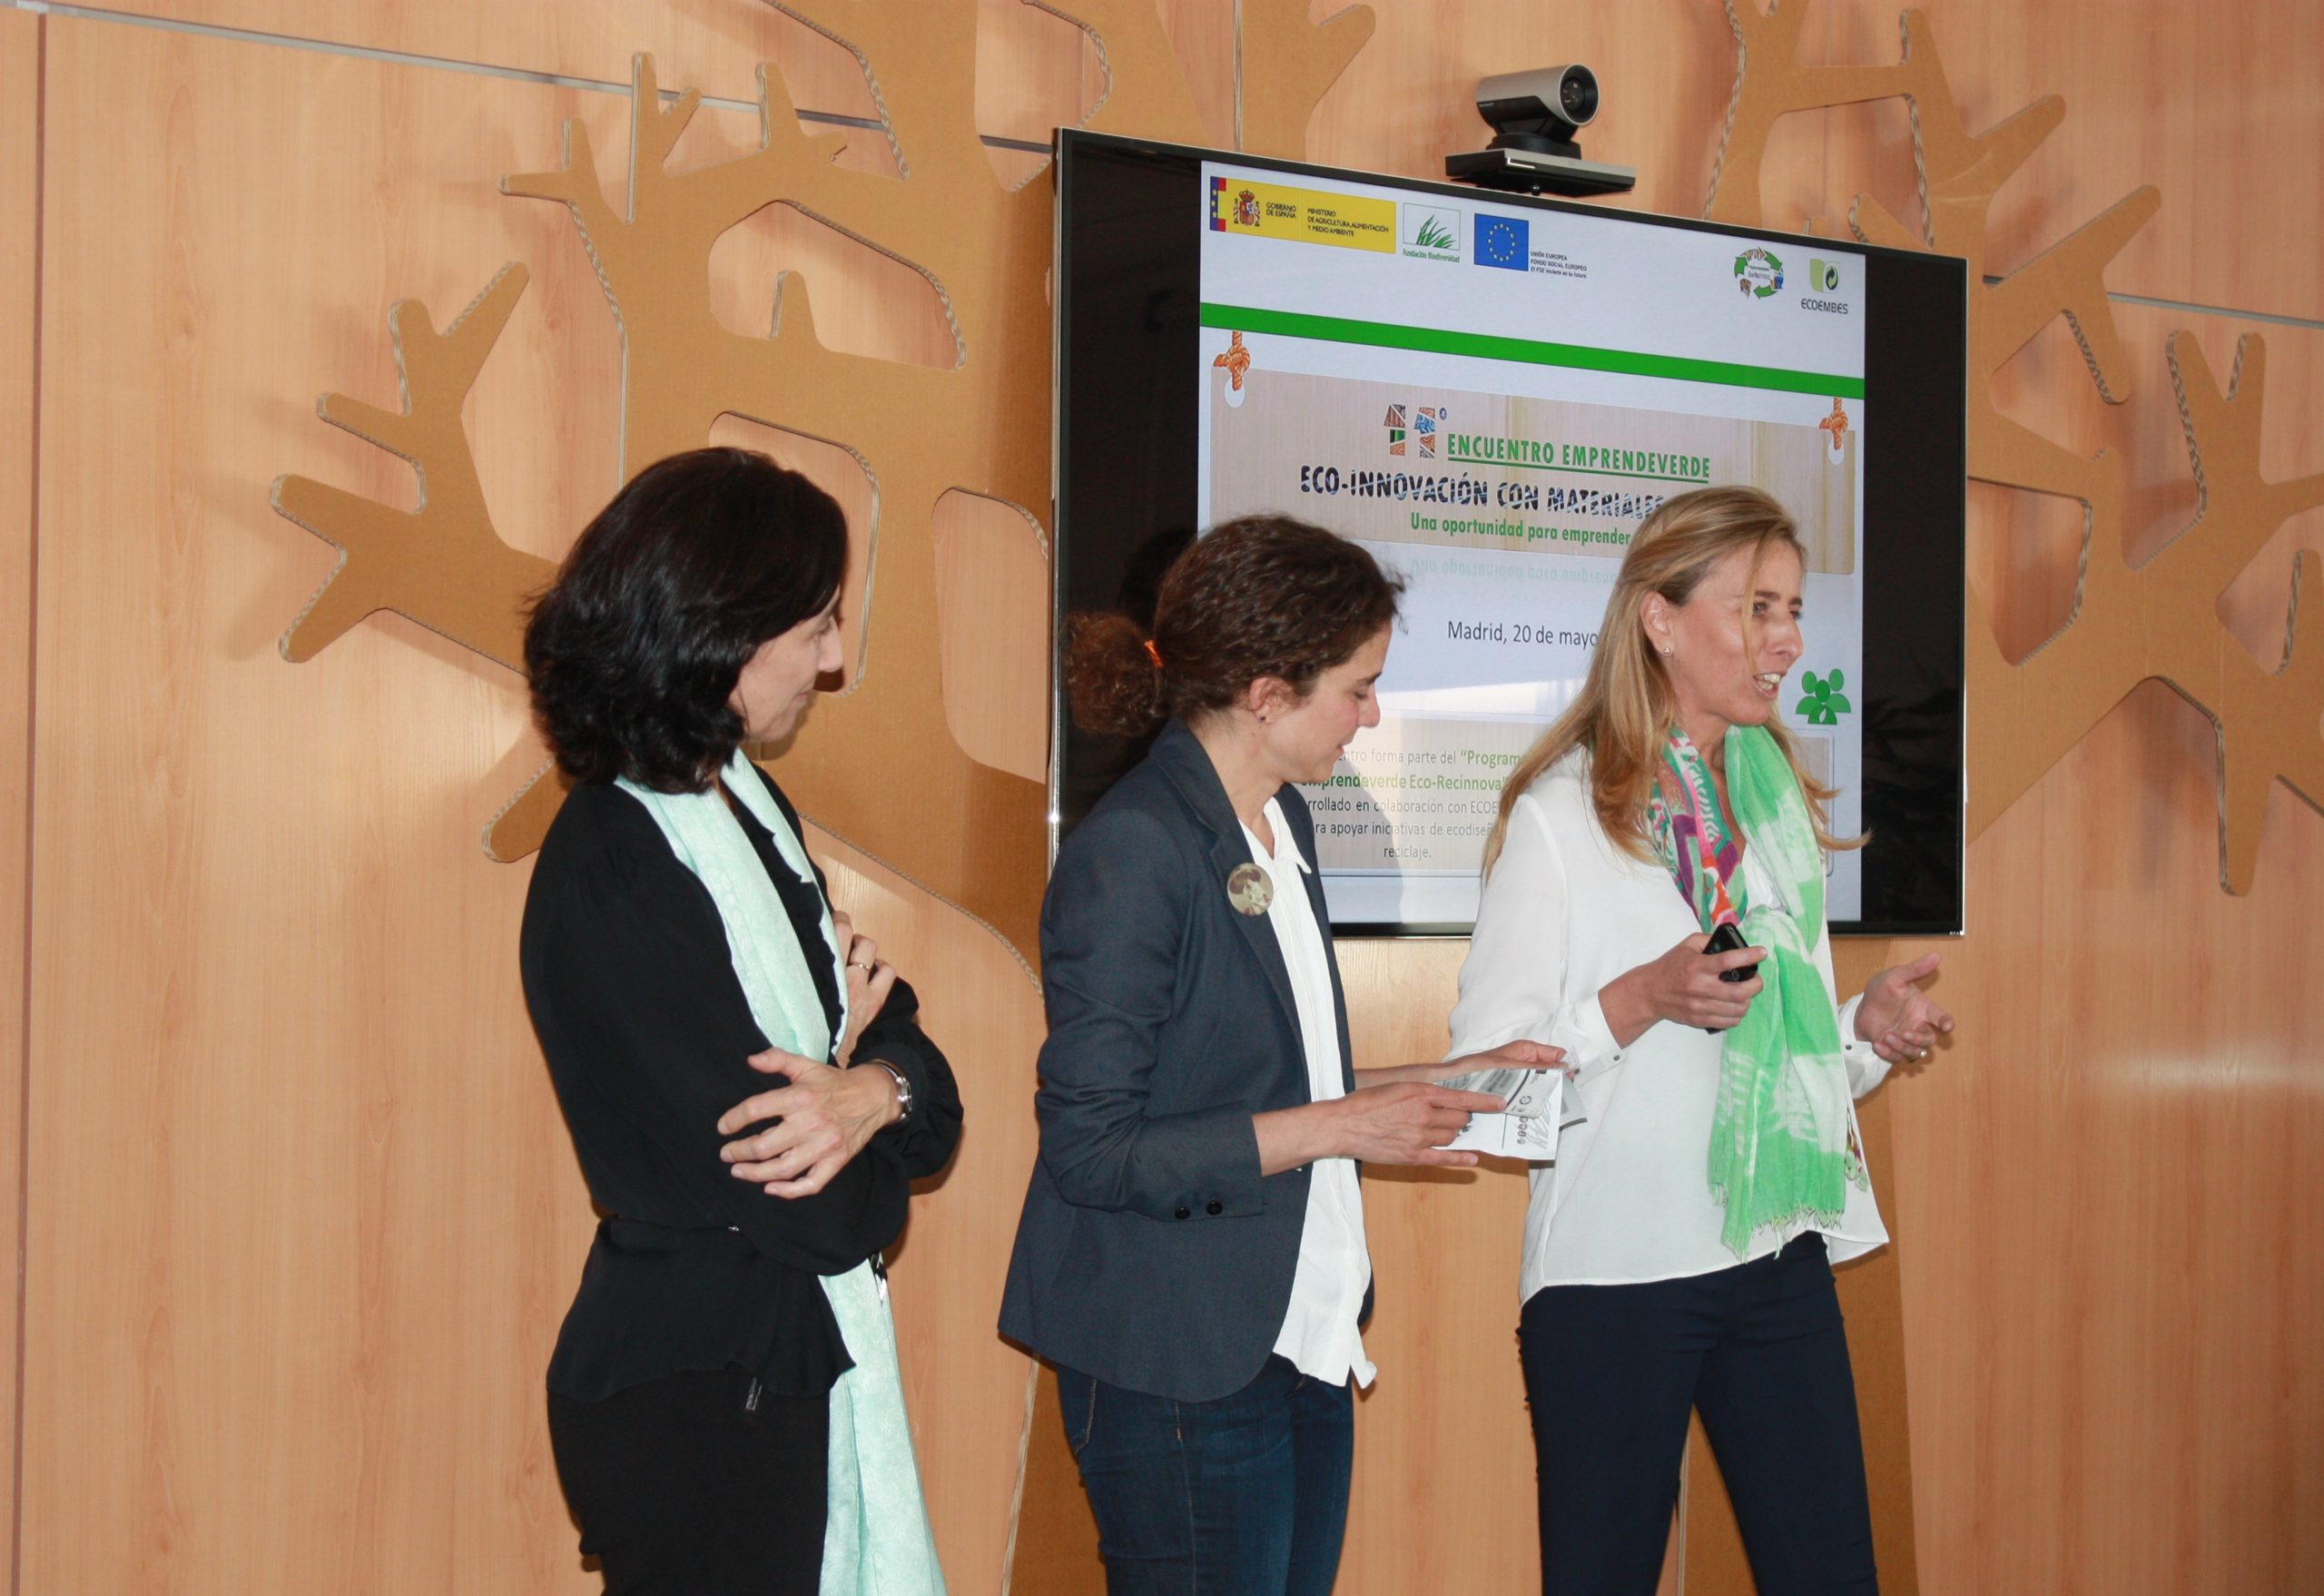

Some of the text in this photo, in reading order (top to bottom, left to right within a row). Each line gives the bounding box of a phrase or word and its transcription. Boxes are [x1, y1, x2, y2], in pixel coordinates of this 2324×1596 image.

[1265, 202, 1297, 212] GOBIERNO
[1265, 209, 1296, 219] DE ESPAÑA
[1307, 208, 1336, 217] MINISTERIO
[1329, 228, 1354, 237] AMBIENTE
[1403, 248, 1461, 263] Fundación Biodiversidad
[1801, 298, 1848, 314] ECOEMBES
[1448, 433, 1554, 465] ENCUENTRO
[1562, 444, 1710, 478] EMPRENDEVERDE
[1301, 465, 1488, 507] ECO-INNOVACIÓN
[1497, 482, 1539, 511] CON
[1411, 511, 1631, 546] Una oportunidad para emprender
[1448, 621, 1599, 650] Madrid, 20 de mayo
[1371, 747, 1403, 763] forma
[1408, 752, 1436, 765] parte
[1440, 750, 1456, 764] del
[1355, 801, 1370, 812] en
[1374, 799, 1443, 813] colaboración
[1447, 803, 1467, 813] con
[1330, 823, 1368, 837] apoyar
[1372, 822, 1425, 835] iniciativas
[1430, 823, 1443, 835] de
[1384, 844, 1432, 862] reciclaje.
